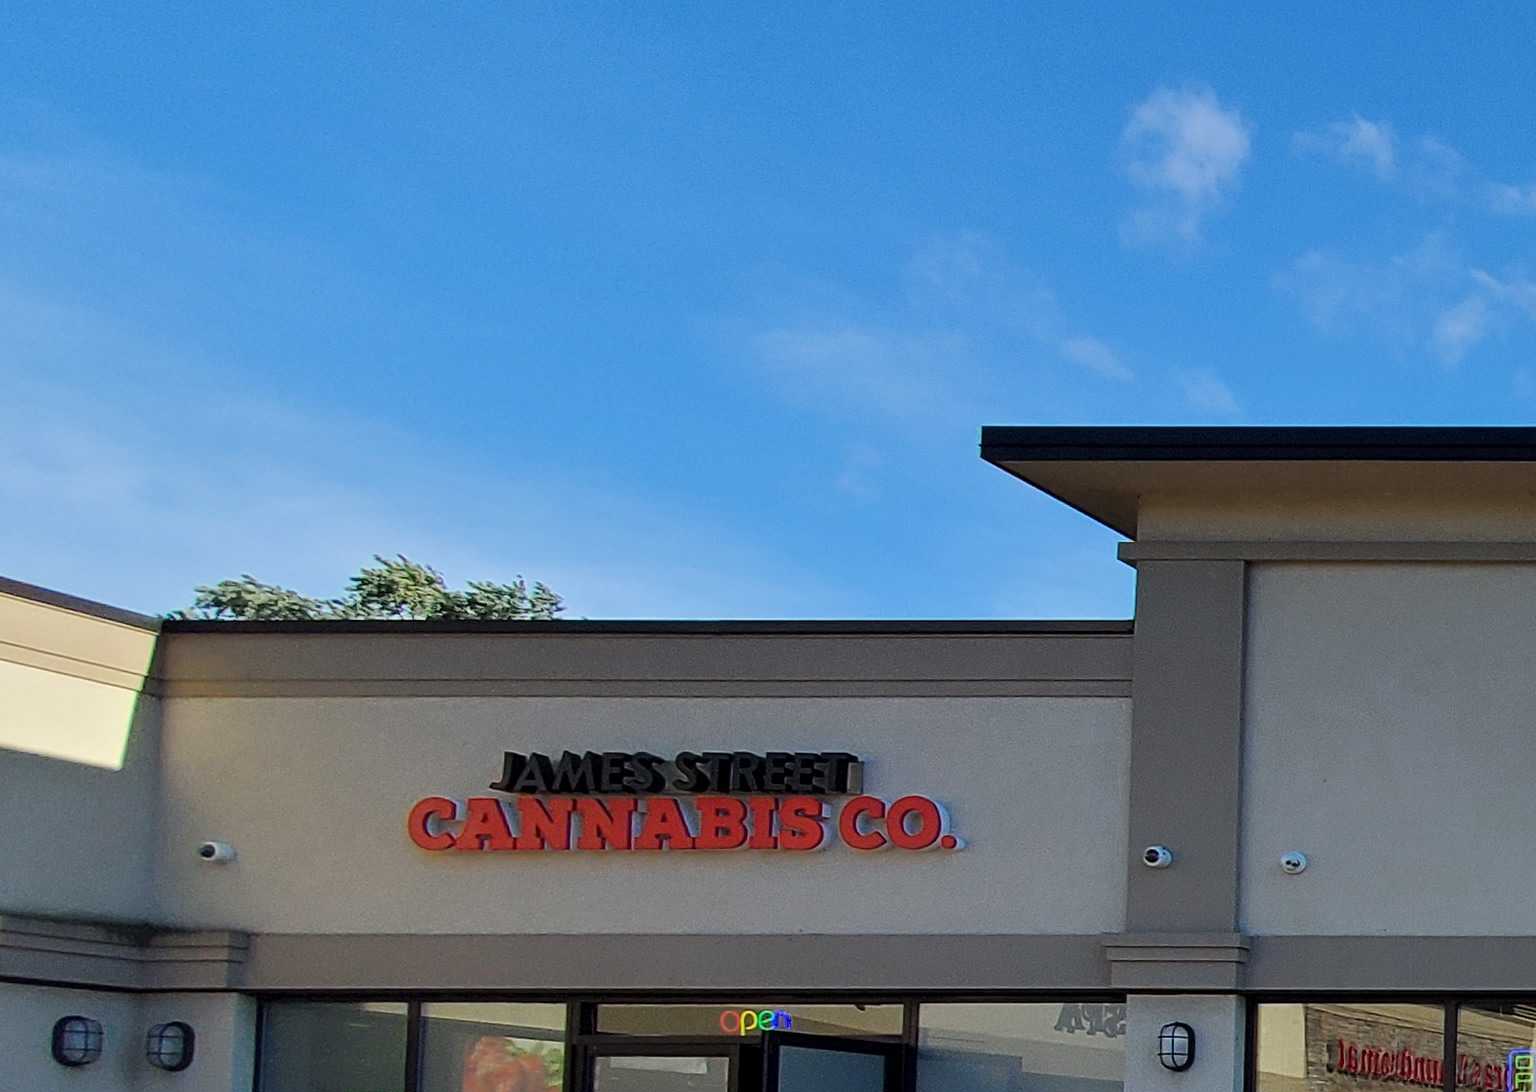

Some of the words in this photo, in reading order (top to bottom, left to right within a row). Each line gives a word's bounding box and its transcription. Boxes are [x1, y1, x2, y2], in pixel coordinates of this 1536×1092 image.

[489, 750, 662, 794] JAMES
[672, 751, 860, 795] STREET
[407, 794, 826, 851] CANNABIS
[838, 794, 960, 851] CO.
[720, 1009, 793, 1036] open
